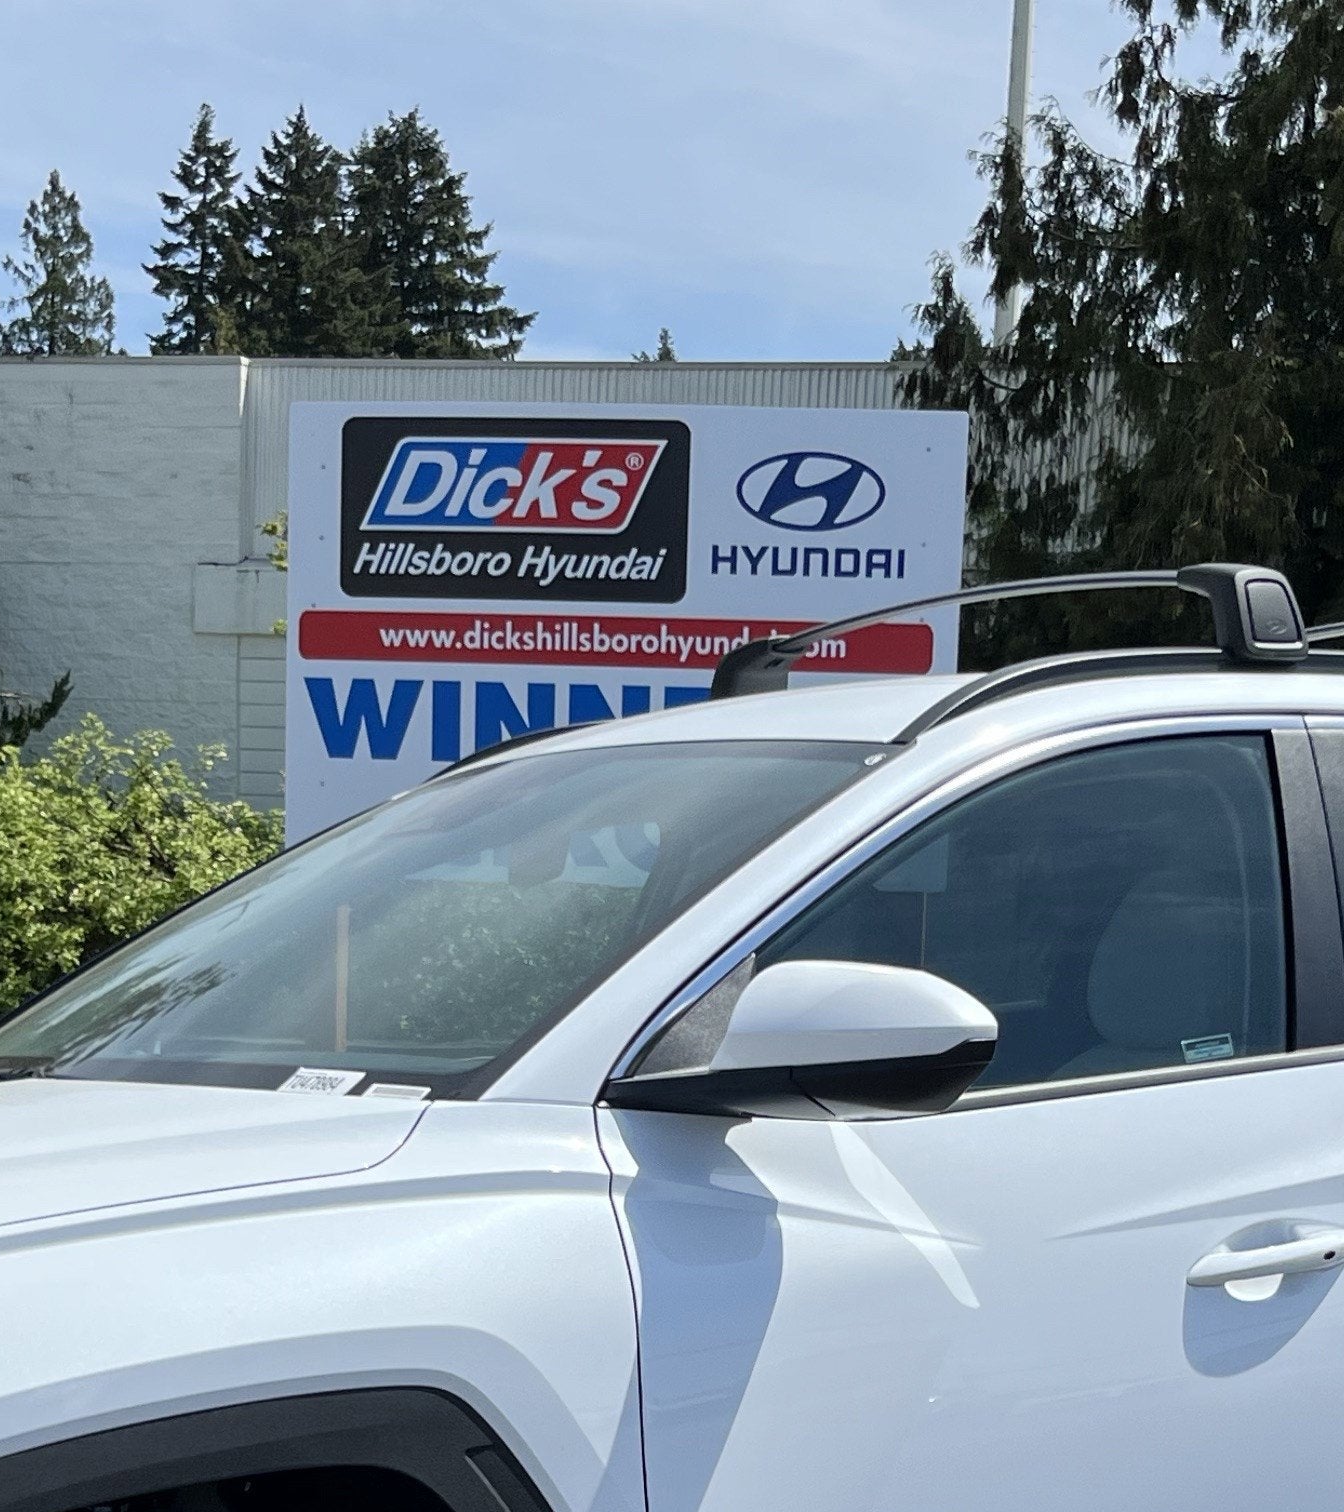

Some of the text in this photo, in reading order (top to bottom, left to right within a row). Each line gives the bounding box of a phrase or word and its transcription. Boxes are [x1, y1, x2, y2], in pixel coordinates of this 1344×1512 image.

[353, 542, 667, 587] Hillsboro Hyundai
[711, 544, 905, 579] HYUNDAI
